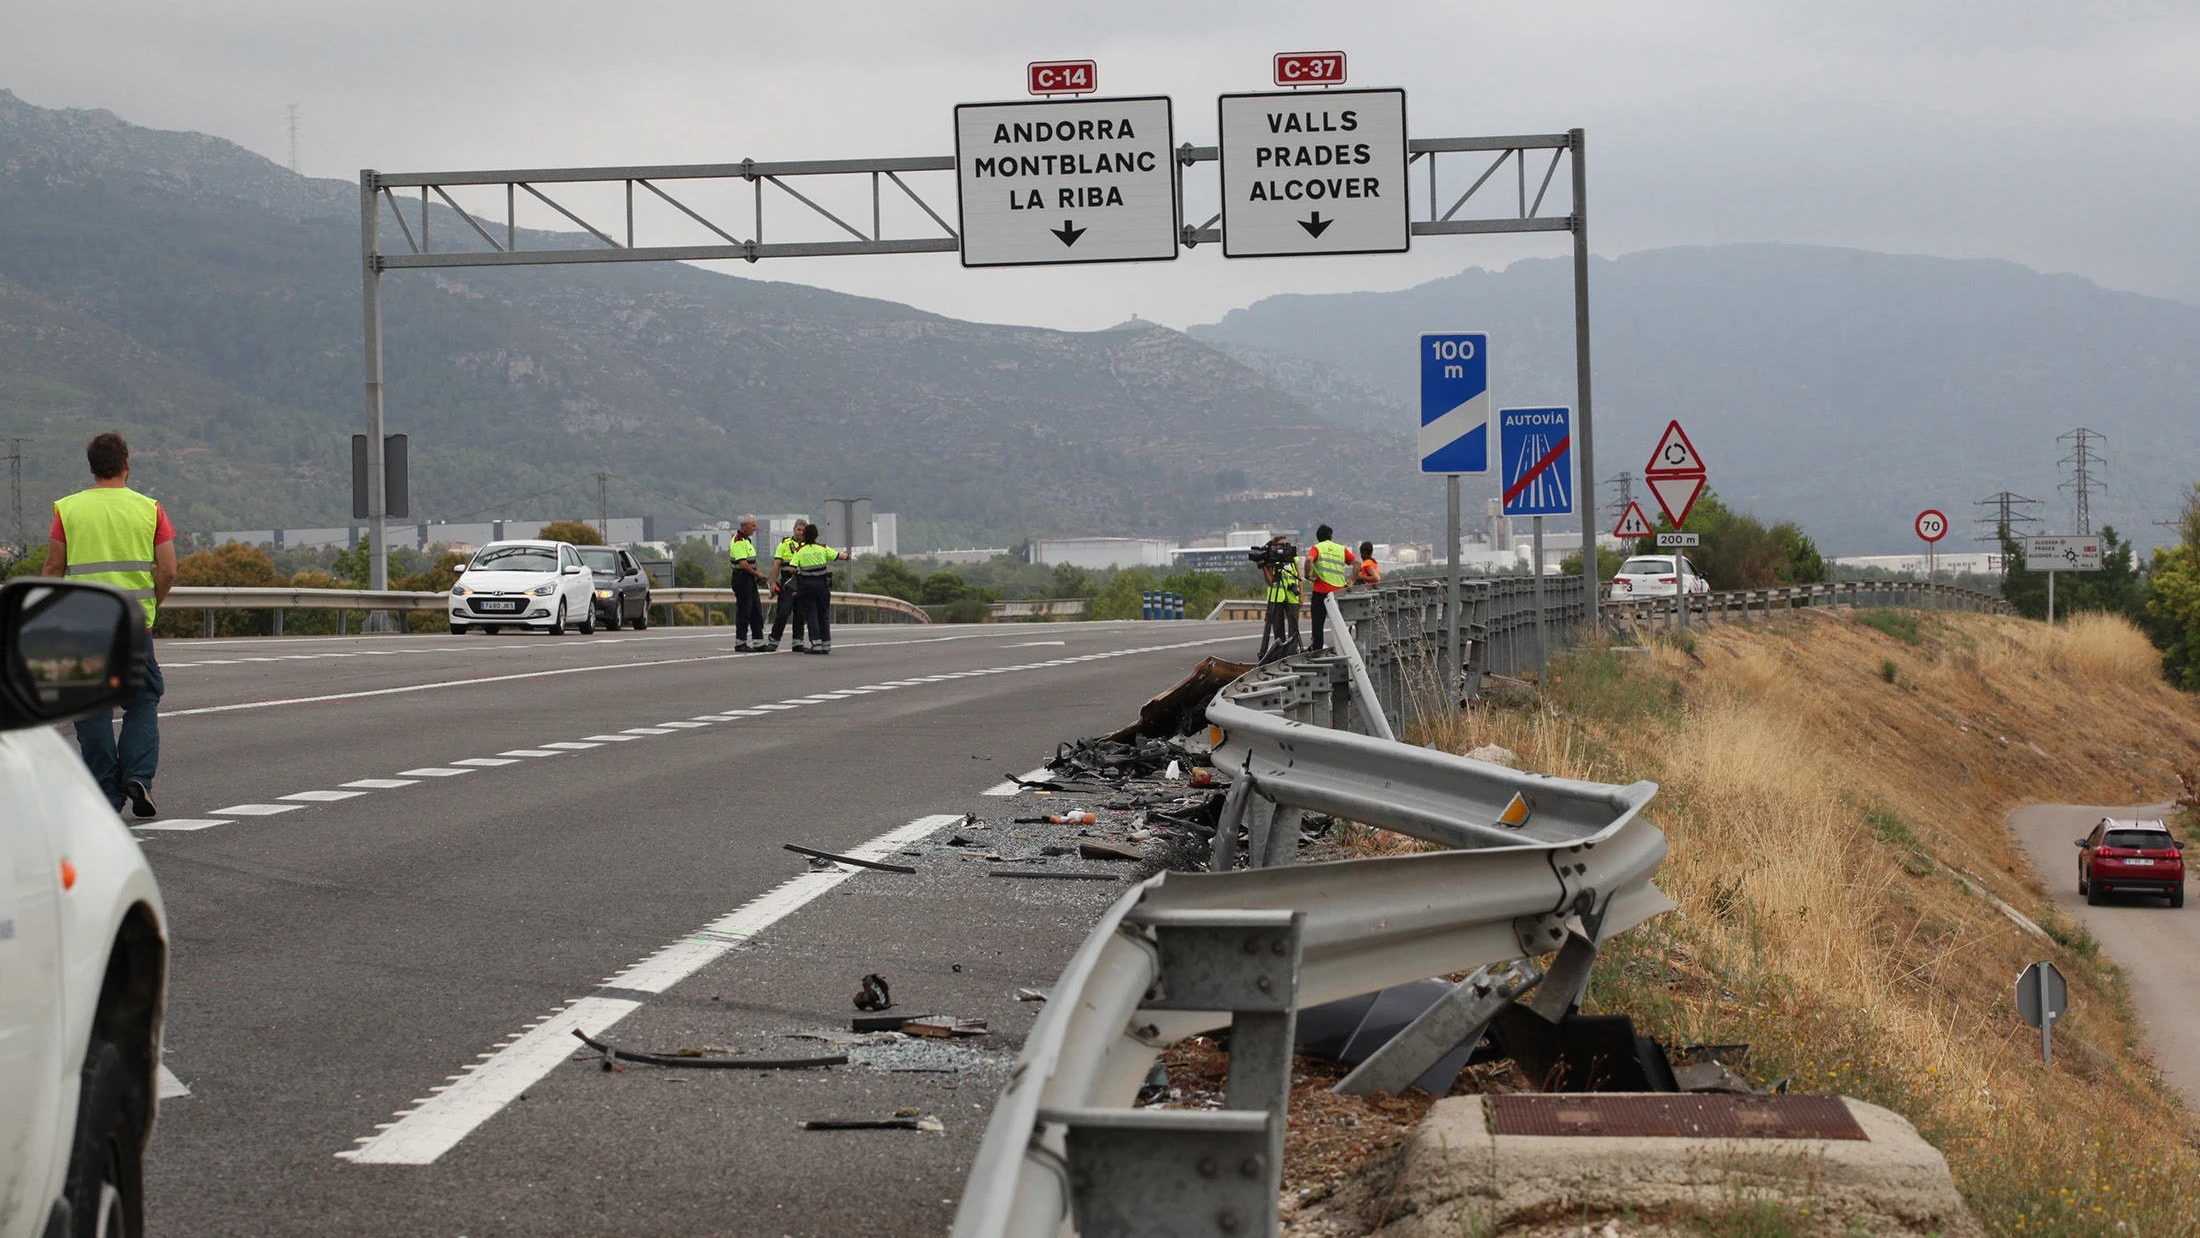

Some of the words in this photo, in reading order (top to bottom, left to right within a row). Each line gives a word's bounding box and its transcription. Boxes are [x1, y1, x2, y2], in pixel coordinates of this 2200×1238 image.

[1038, 67, 1088, 89] C-14
[1284, 59, 1336, 79] C-37
[993, 118, 1135, 144] ANDORRA
[1267, 110, 1358, 134] VALLS
[975, 151, 1156, 178] MONTBLANC
[1256, 143, 1371, 168] PRADES
[1010, 189, 1045, 211] LA
[1058, 186, 1124, 209] RIBA
[1249, 177, 1380, 202] ALCOVER
[1432, 340, 1475, 361] 100
[1444, 365, 1463, 379] m
[1505, 411, 1565, 426] AUTOVÍA
[1923, 520, 1940, 532] 70
[1660, 534, 1683, 545] 200
[1686, 537, 1696, 545] m
[1626, 582, 1633, 592] 3
